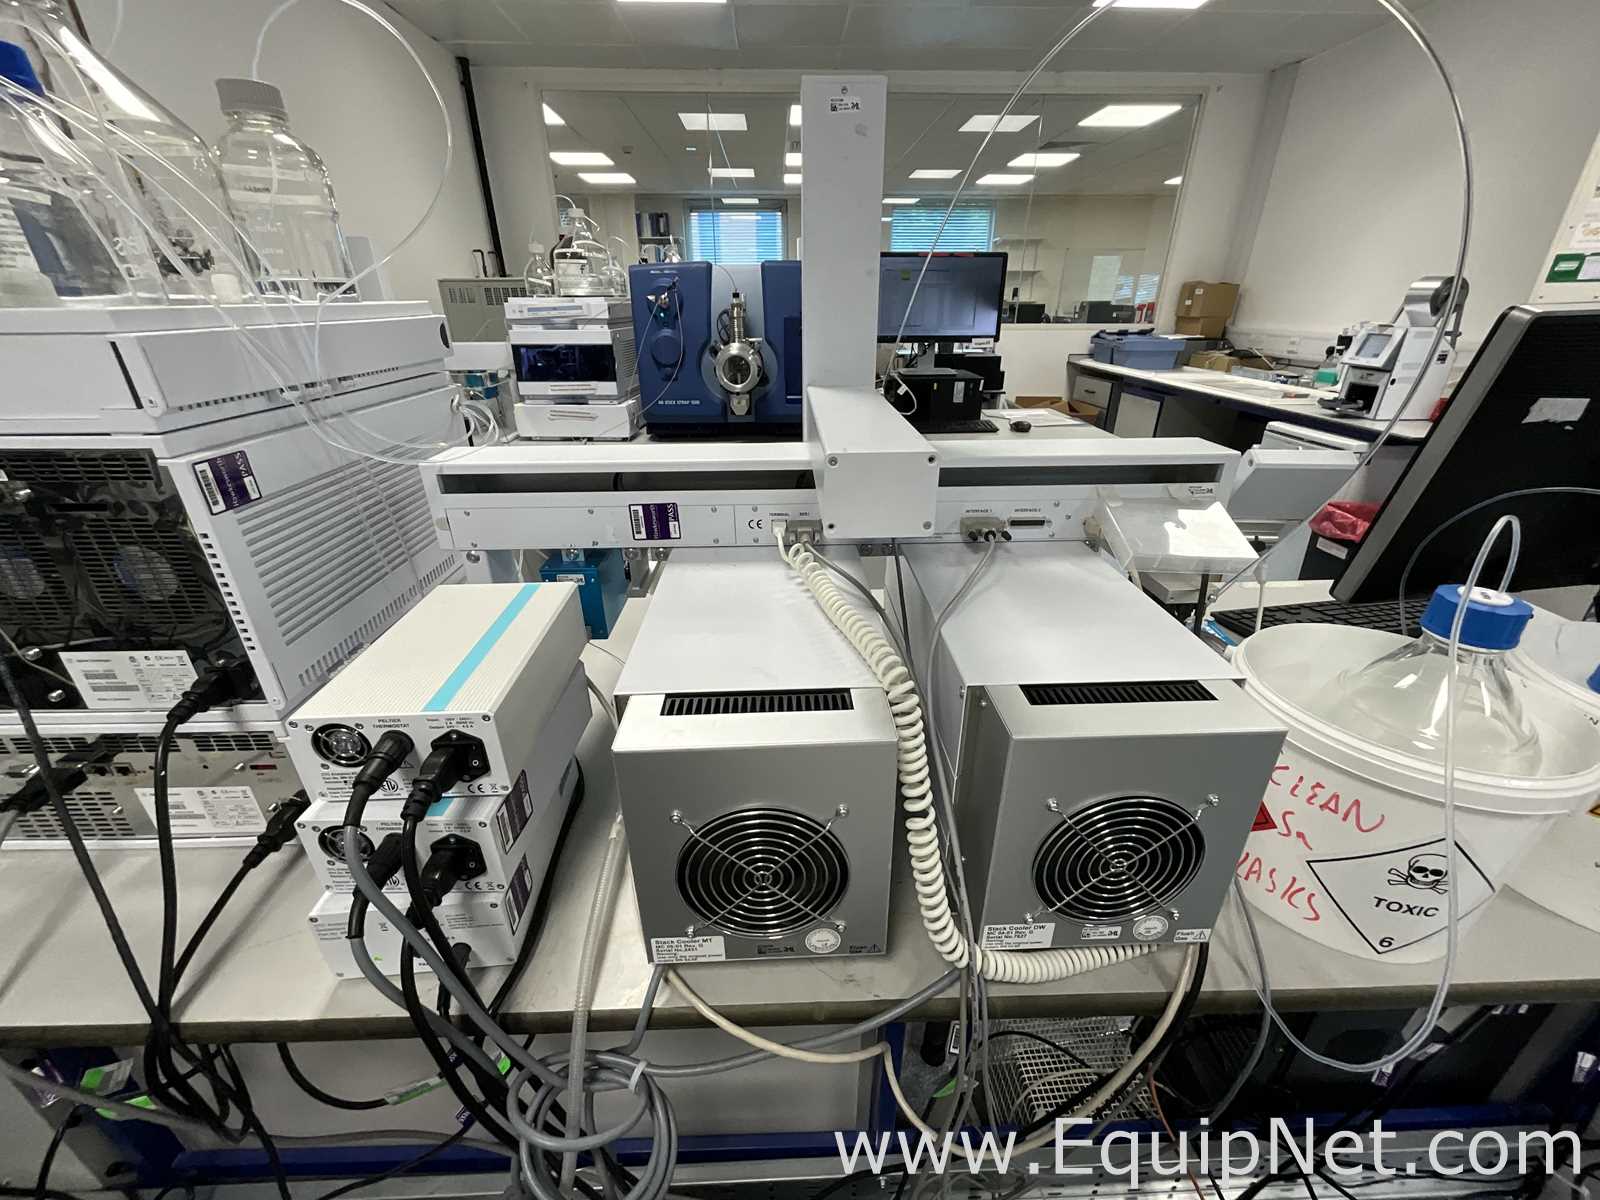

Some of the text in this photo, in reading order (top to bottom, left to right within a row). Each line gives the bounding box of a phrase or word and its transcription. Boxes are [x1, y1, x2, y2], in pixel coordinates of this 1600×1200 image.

[667, 503, 675, 521] PASS
[1373, 896, 1440, 917] TOXIC
[1379, 936, 1395, 948] 6
